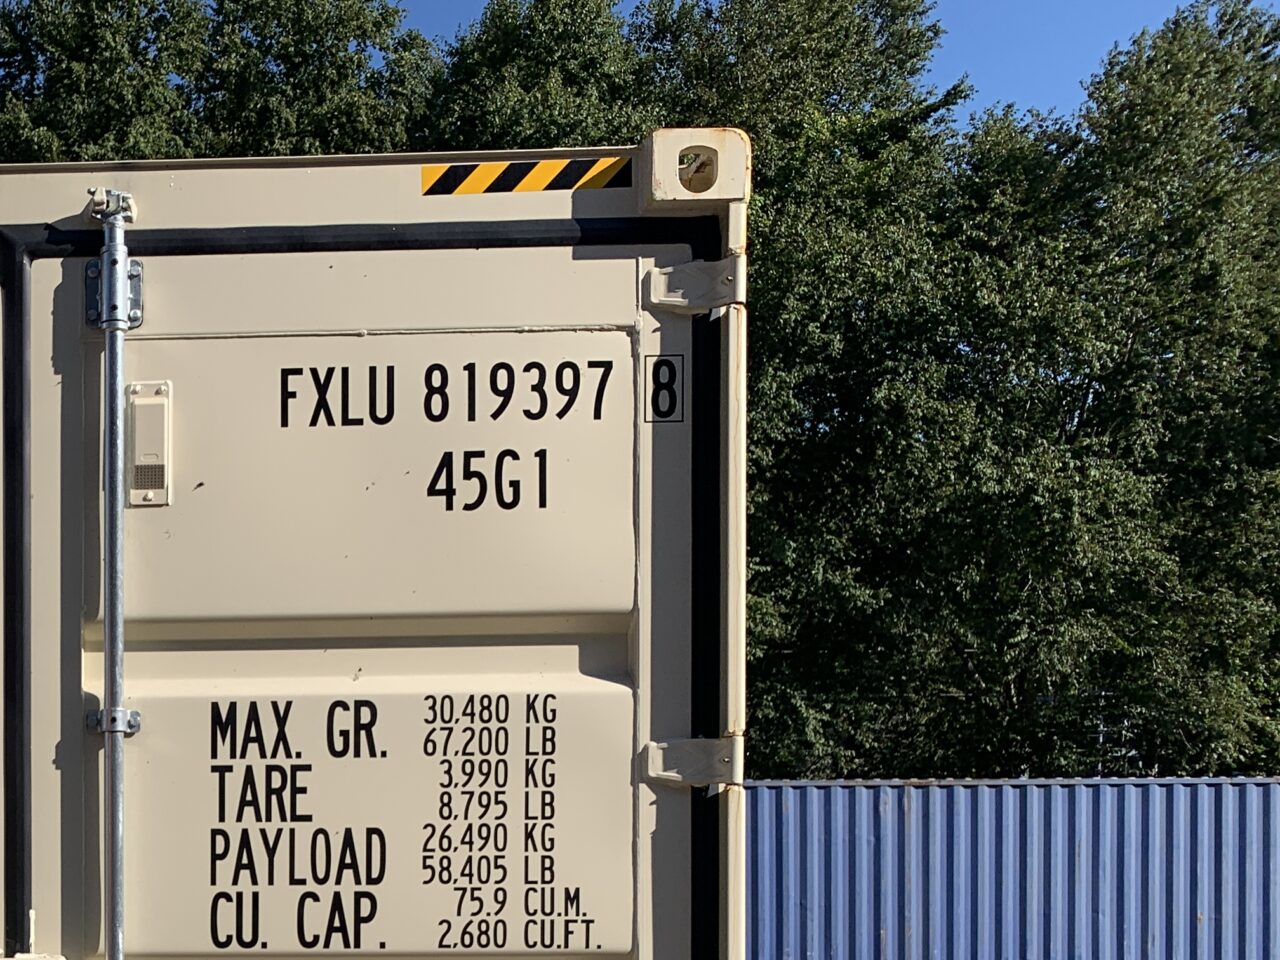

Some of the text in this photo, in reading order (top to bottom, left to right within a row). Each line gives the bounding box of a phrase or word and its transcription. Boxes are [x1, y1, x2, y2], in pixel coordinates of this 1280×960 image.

[280, 359, 678, 428] FXLU 819397 8
[425, 448, 548, 512] 45G1
[210, 693, 558, 760] MAX. GR. 30,480 KG
[422, 726, 557, 757] 67,200 LB
[210, 758, 556, 823] TARE 3,990 KG
[438, 790, 556, 822] 8,795 LB
[209, 823, 556, 886] PAYLOAD 26,490 KG
[422, 855, 556, 887] 58,405 LB
[209, 887, 588, 950] CU. CAP. 75.9 CU.M.
[437, 919, 602, 950] 2,680 CU.FT.
